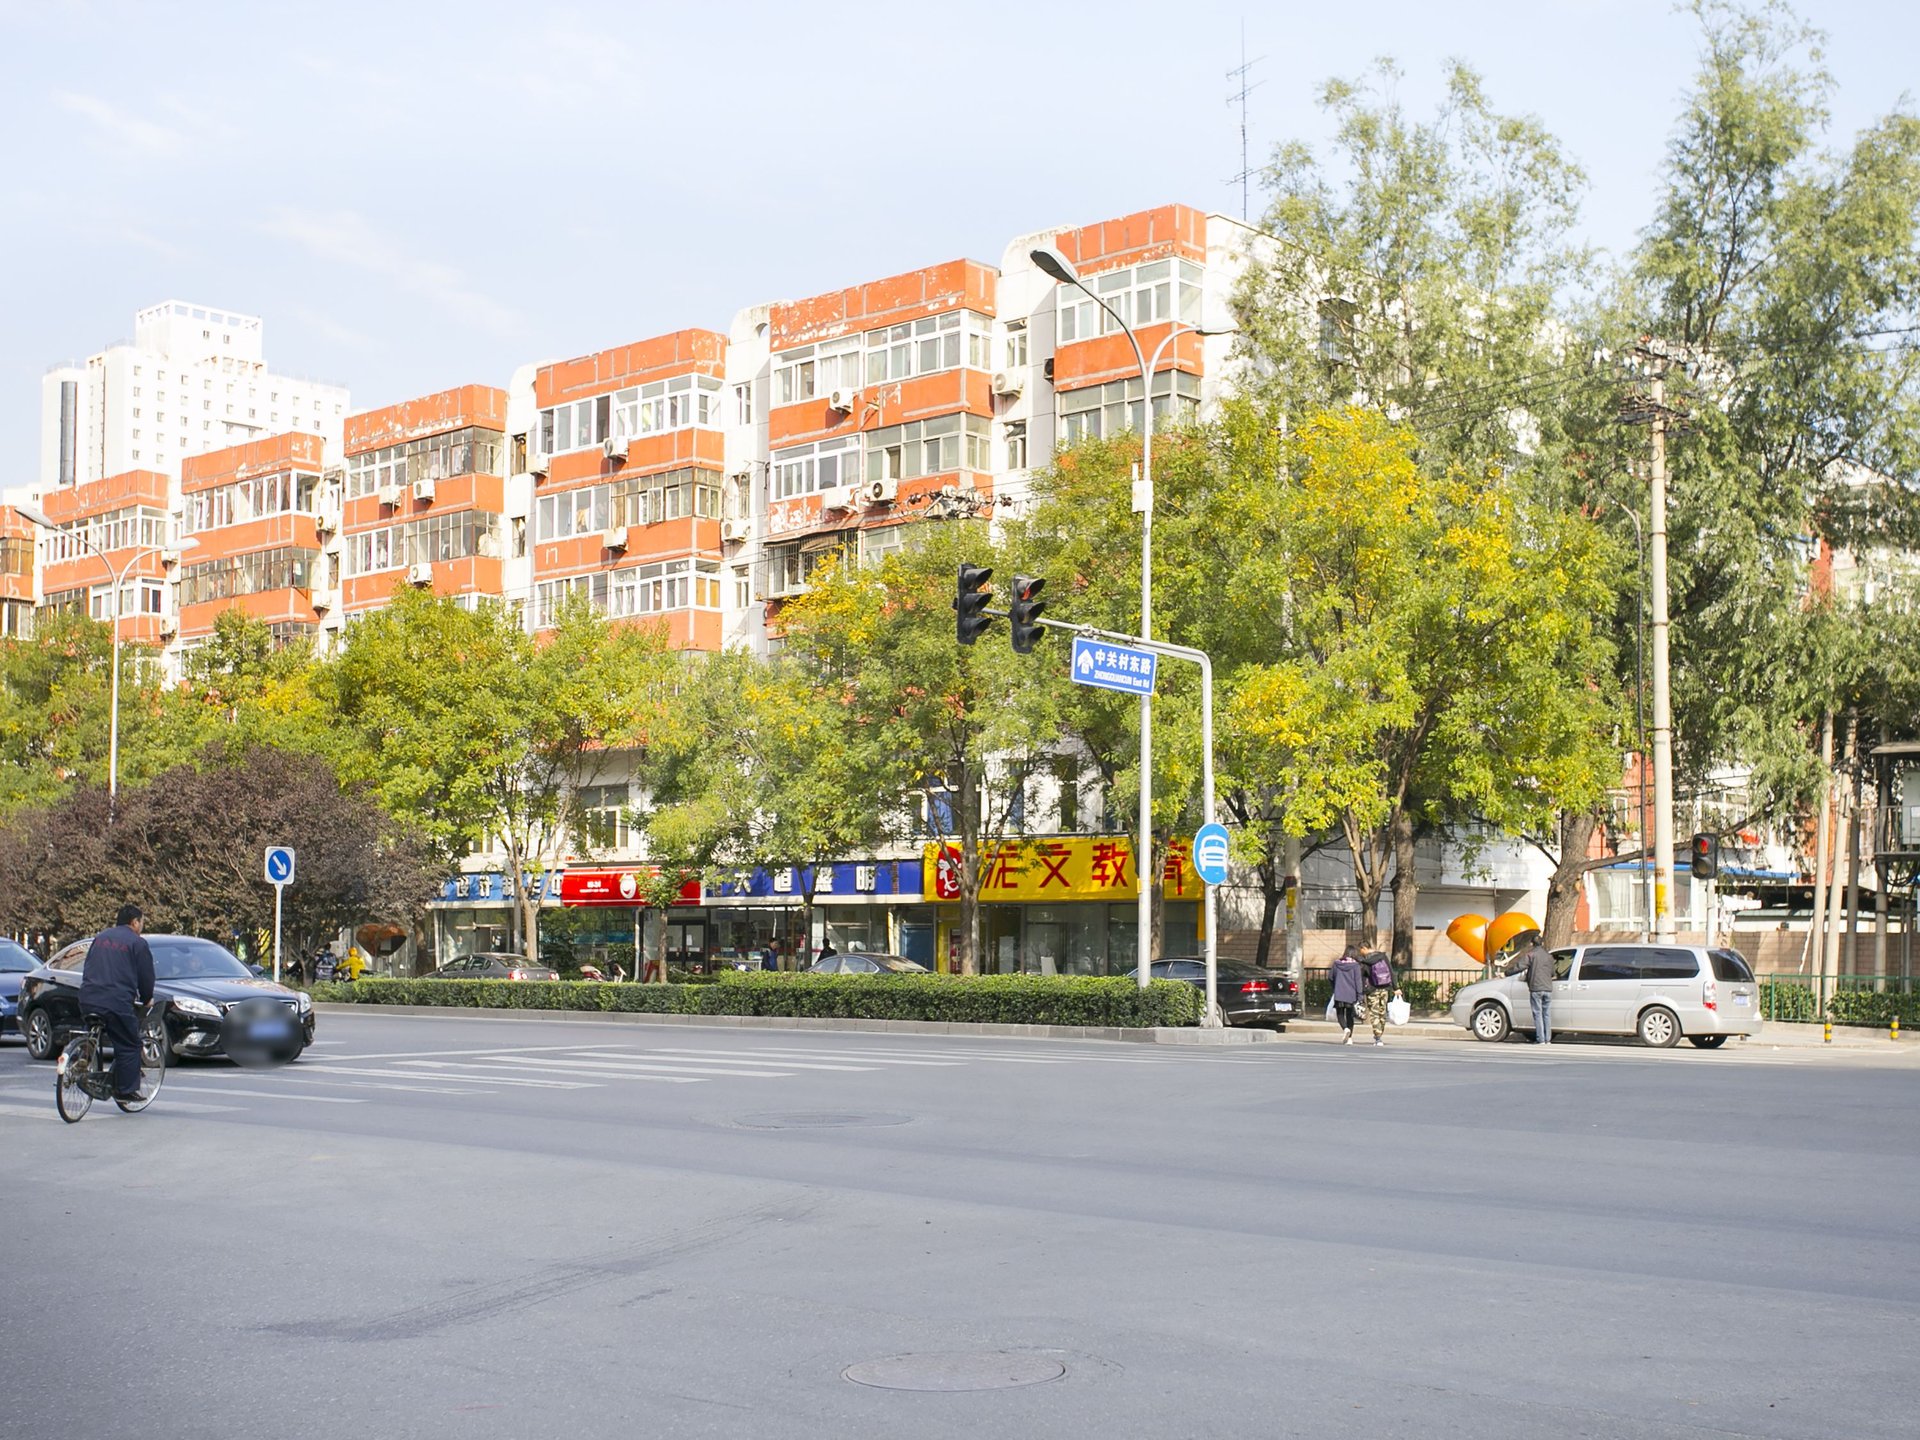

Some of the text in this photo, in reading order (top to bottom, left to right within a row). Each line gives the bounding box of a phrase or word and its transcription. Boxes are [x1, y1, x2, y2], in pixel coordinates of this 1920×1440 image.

[1095, 648, 1151, 675] 中关村东路
